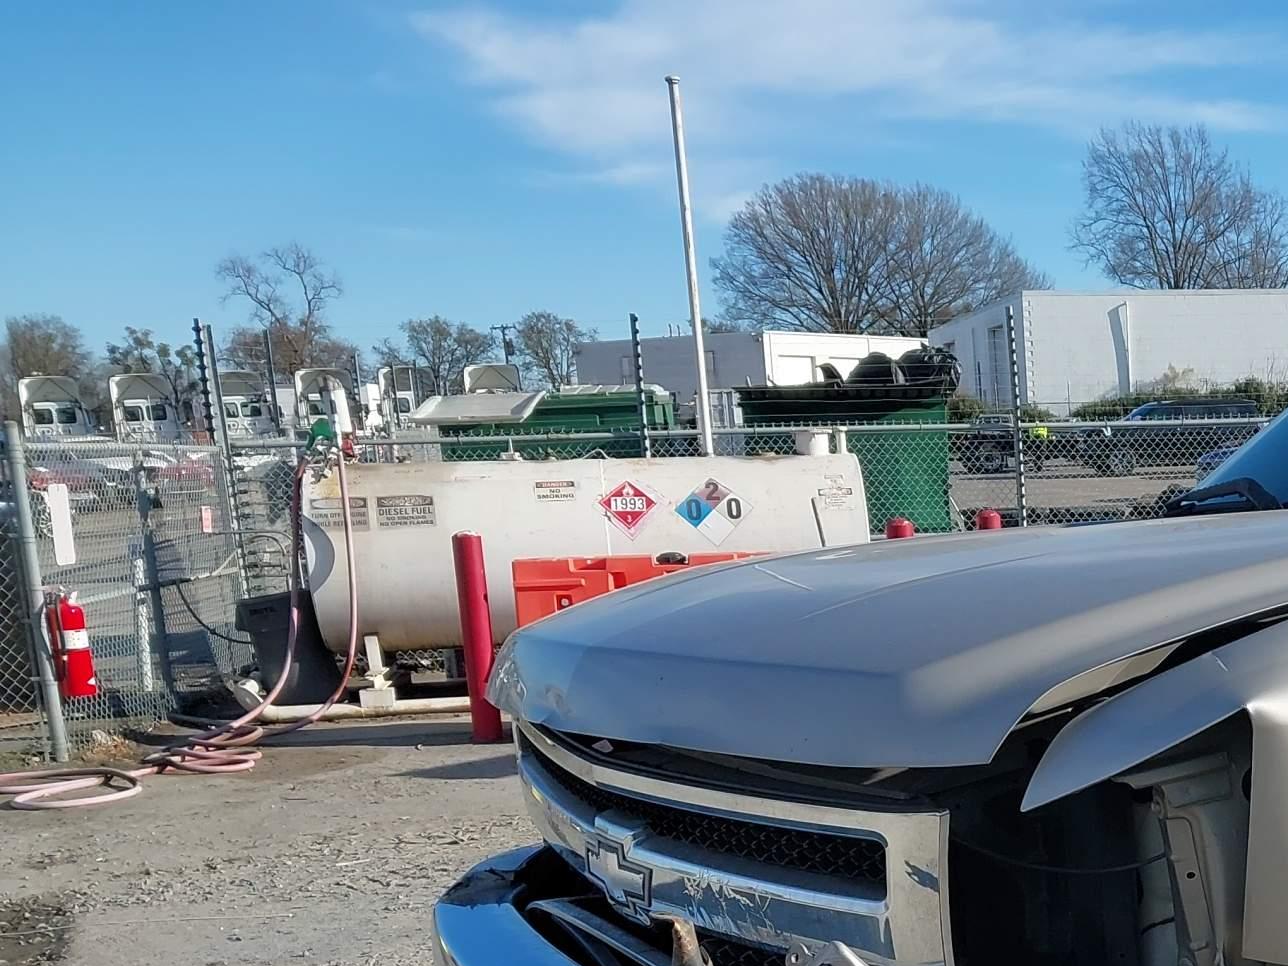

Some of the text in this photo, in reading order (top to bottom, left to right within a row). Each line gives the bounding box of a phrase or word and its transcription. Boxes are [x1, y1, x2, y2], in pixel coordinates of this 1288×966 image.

[704, 481, 721, 501] 2
[378, 506, 433, 516] DIESEL FUEL
[613, 498, 645, 510] 1993
[686, 497, 742, 521] 0 0
